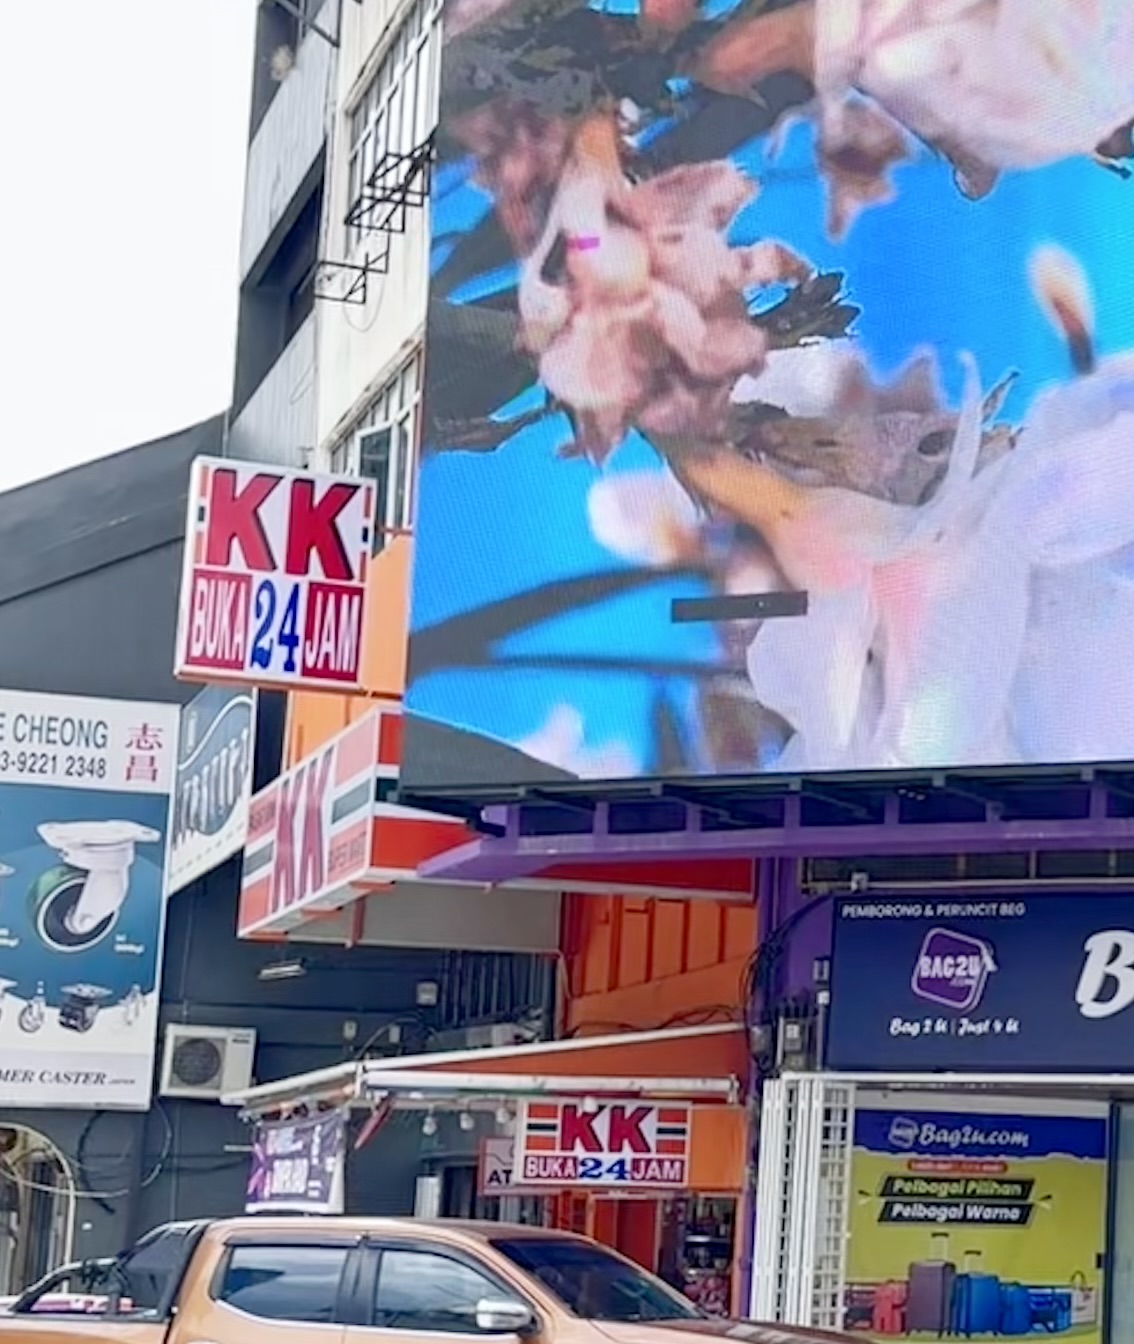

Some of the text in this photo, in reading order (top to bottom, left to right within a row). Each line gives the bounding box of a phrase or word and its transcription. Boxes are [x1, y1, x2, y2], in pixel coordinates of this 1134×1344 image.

[205, 468, 361, 581] KK
[190, 578, 361, 674] BUKA 24 JAM
[13, 714, 108, 749] CHEONG
[65, 756, 107, 779] 2348
[842, 904, 922, 918] PEMBORONG
[936, 903, 998, 917] PERUNCIT
[999, 902, 1026, 916] BEG
[919, 955, 982, 978] BAG2U
[890, 1017, 921, 1037] Bag
[958, 1017, 990, 1037] Just
[39, 1071, 107, 1086] CASTER
[560, 1104, 653, 1153] KK
[918, 1122, 1029, 1148] Bag2u.com
[526, 1157, 681, 1181] BUKA 24 JAM
[892, 1179, 964, 1197] Pelbagai
[891, 1203, 1021, 1222] Pelbagai Warna
